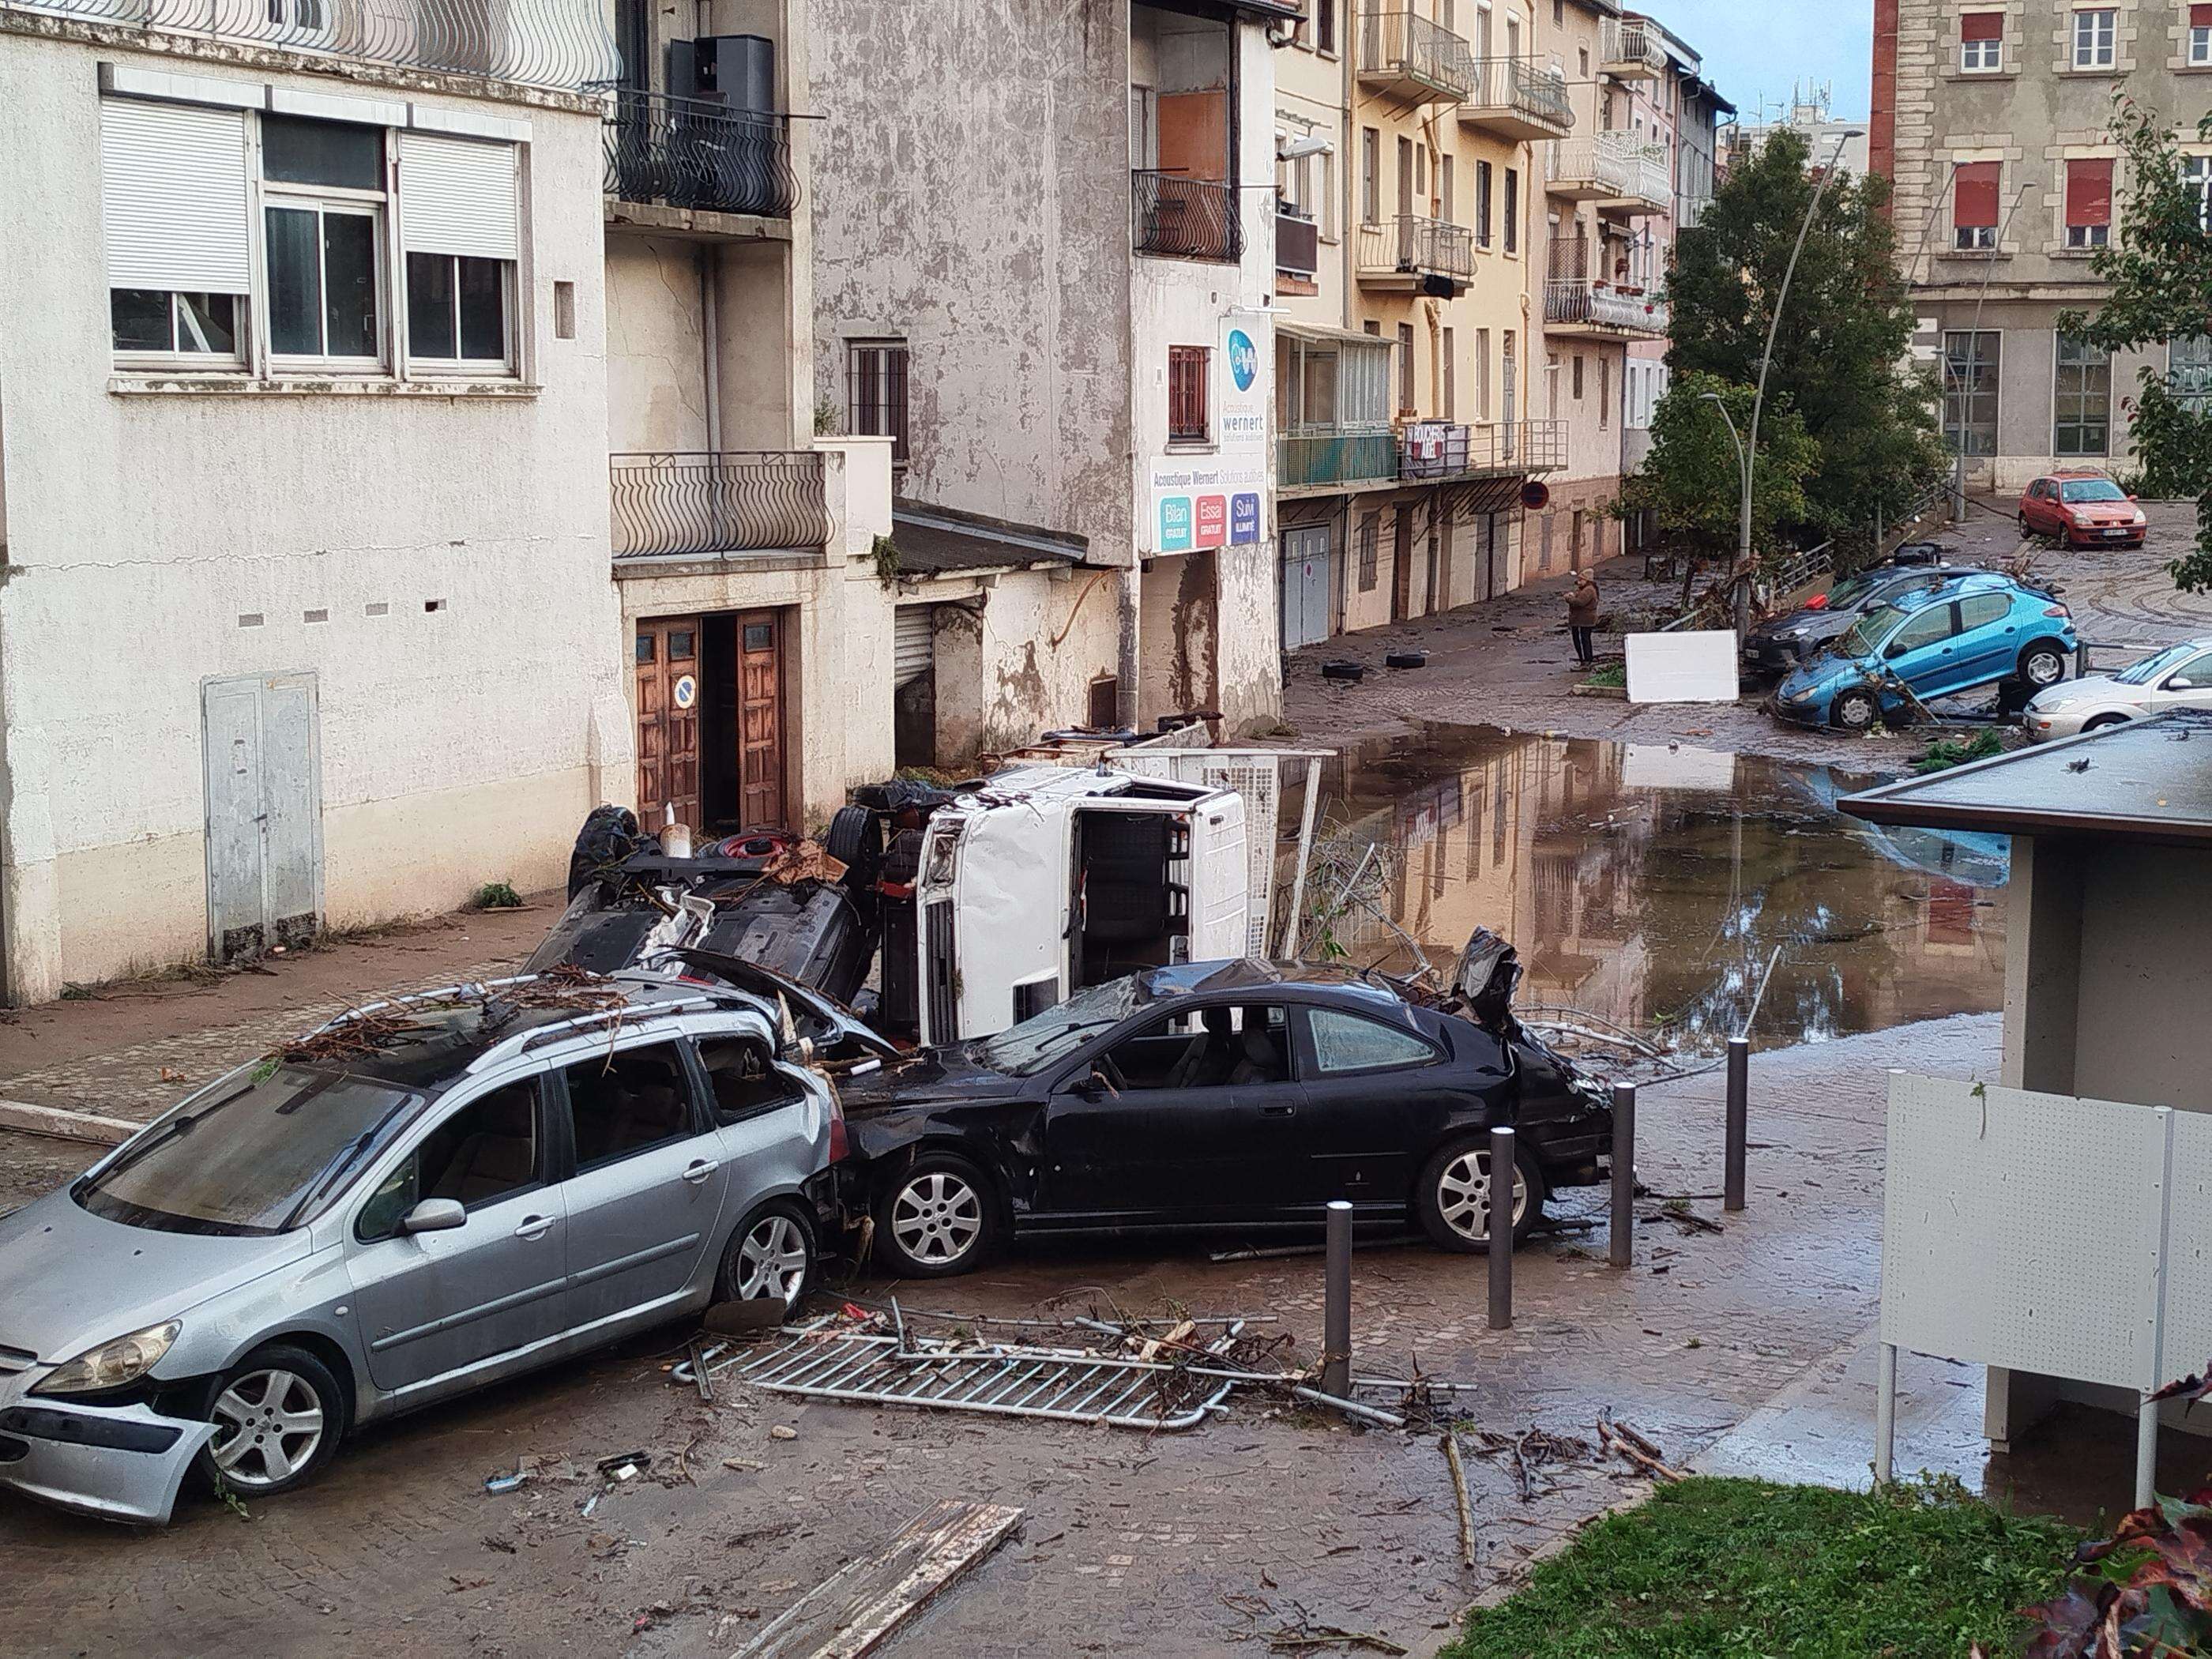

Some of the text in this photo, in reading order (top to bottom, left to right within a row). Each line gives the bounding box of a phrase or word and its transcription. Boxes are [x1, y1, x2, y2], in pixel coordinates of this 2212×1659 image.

[1223, 414, 1263, 431] wernert
[1153, 472, 1191, 489] Acoustique
[1192, 470, 1219, 485] Wernert
[1220, 469, 1243, 484] Solutions
[1165, 504, 1187, 523] Bilan
[1200, 501, 1222, 520] Essai
[1236, 498, 1255, 517] Suivi
[1165, 528, 1187, 540] GRATUIT
[1200, 524, 1222, 536] GRATUIT
